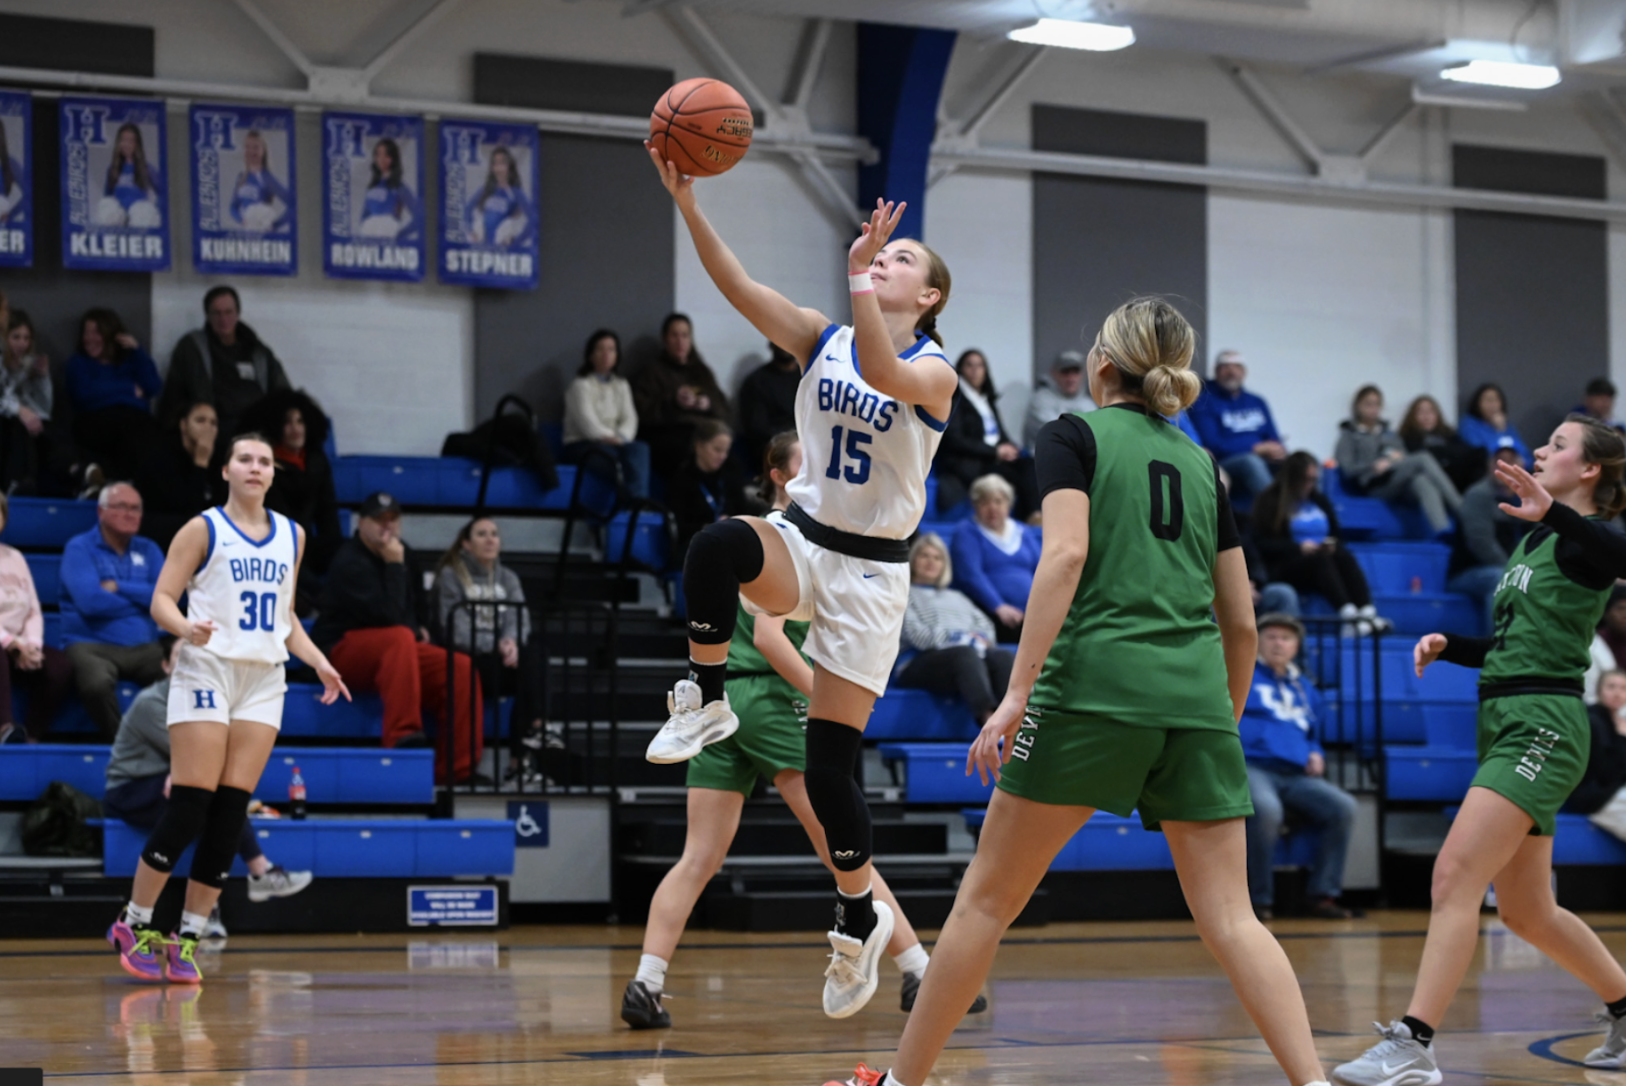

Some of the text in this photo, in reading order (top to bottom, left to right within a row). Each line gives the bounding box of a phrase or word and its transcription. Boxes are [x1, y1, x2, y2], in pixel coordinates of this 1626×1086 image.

[70, 231, 163, 259] KLEIER
[330, 243, 419, 271] ROWLAND
[818, 378, 898, 432] BIRDS
[825, 425, 873, 485] 15
[1148, 459, 1184, 542] 0
[229, 557, 288, 585] BIRDS
[239, 590, 277, 632] 30
[193, 689, 217, 709] H
[1515, 727, 1560, 782] DEVILS
